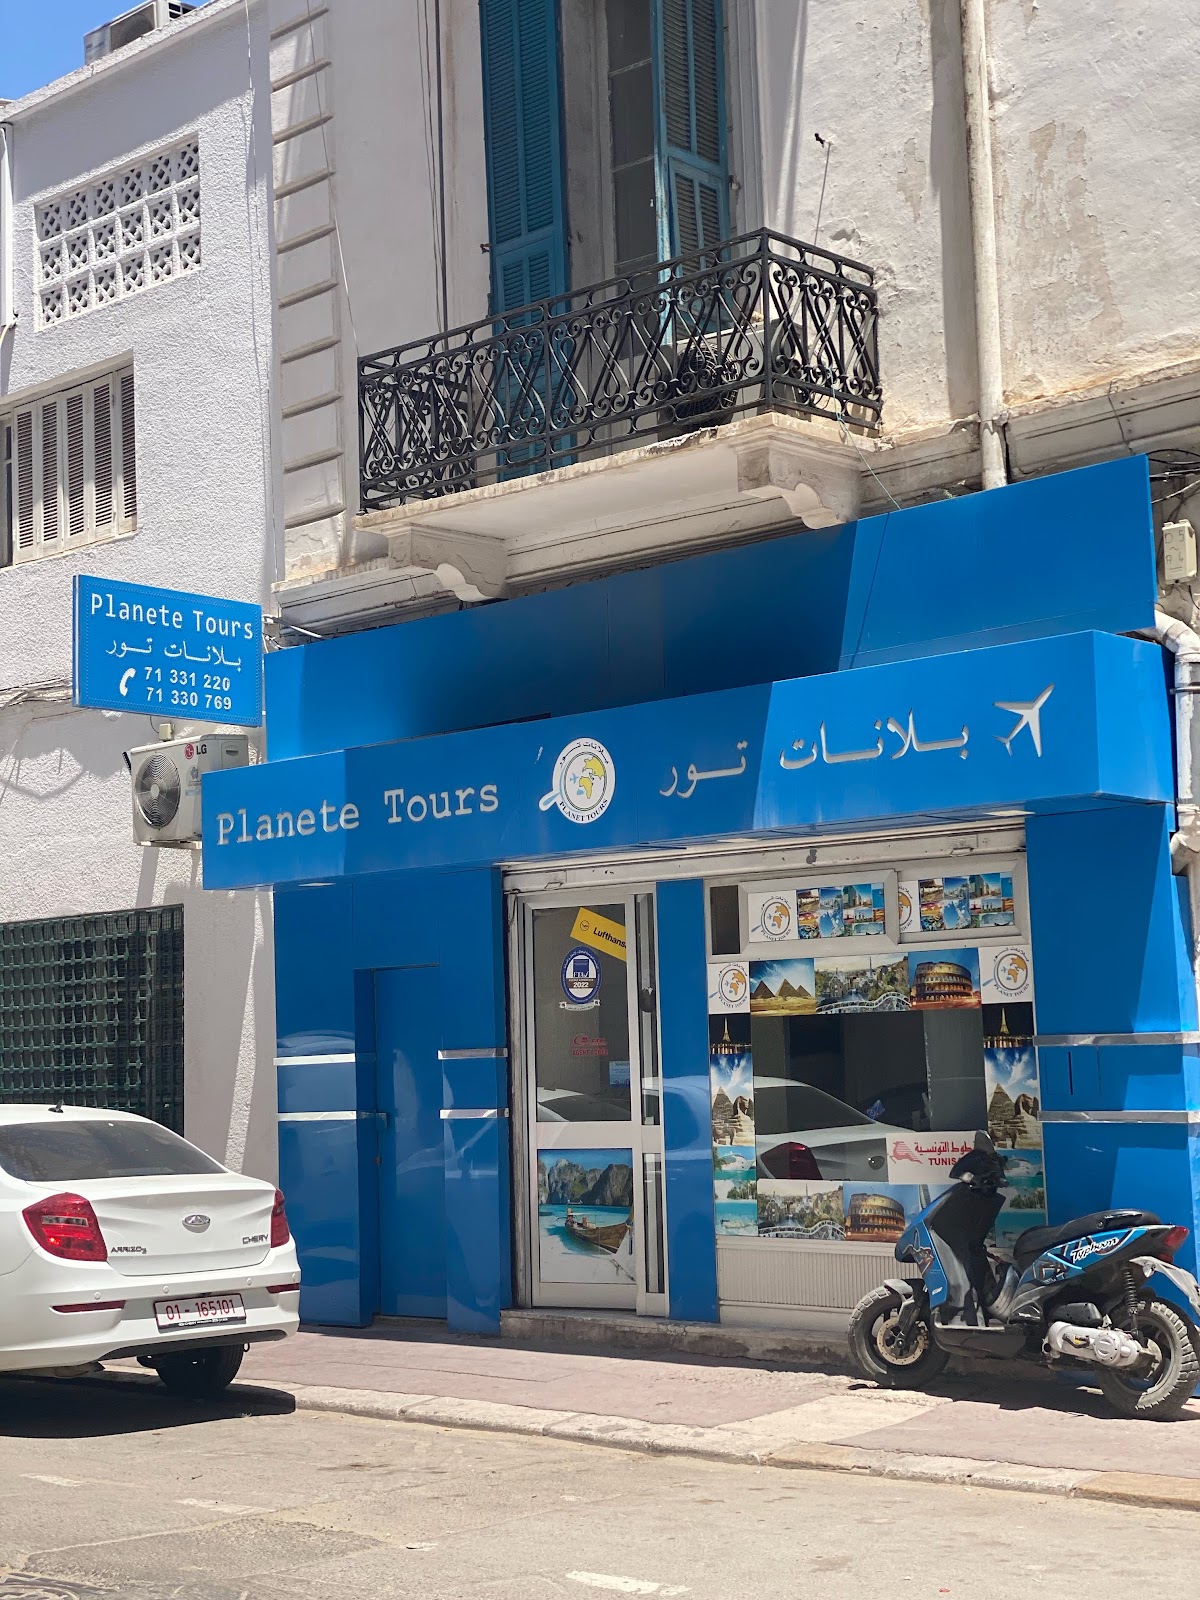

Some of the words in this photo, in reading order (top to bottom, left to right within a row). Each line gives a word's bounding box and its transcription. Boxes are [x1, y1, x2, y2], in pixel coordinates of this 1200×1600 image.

[91, 593, 183, 629] Planete
[192, 610, 253, 640] Tours
[144, 666, 162, 682] 71
[169, 669, 196, 687] 331
[203, 674, 231, 691] 220
[146, 687, 163, 702] 71
[170, 690, 198, 707] 330
[204, 694, 232, 710] 769
[196, 743, 208, 755] LG
[779, 707, 969, 770] بلانات
[659, 740, 749, 799] تور
[216, 799, 360, 846] Planete
[384, 783, 499, 824] Tours
[559, 801, 585, 822] PLANET
[586, 799, 608, 821] TOURS
[914, 1141, 949, 1155] التونسية
[951, 1140, 974, 1155] طوط
[928, 1157, 957, 1166] TUNIS
[242, 1234, 269, 1244] CHERY
[1070, 1237, 1119, 1264] Typhoon
[165, 1304, 181, 1320] 01
[195, 1299, 236, 1318] 165101
